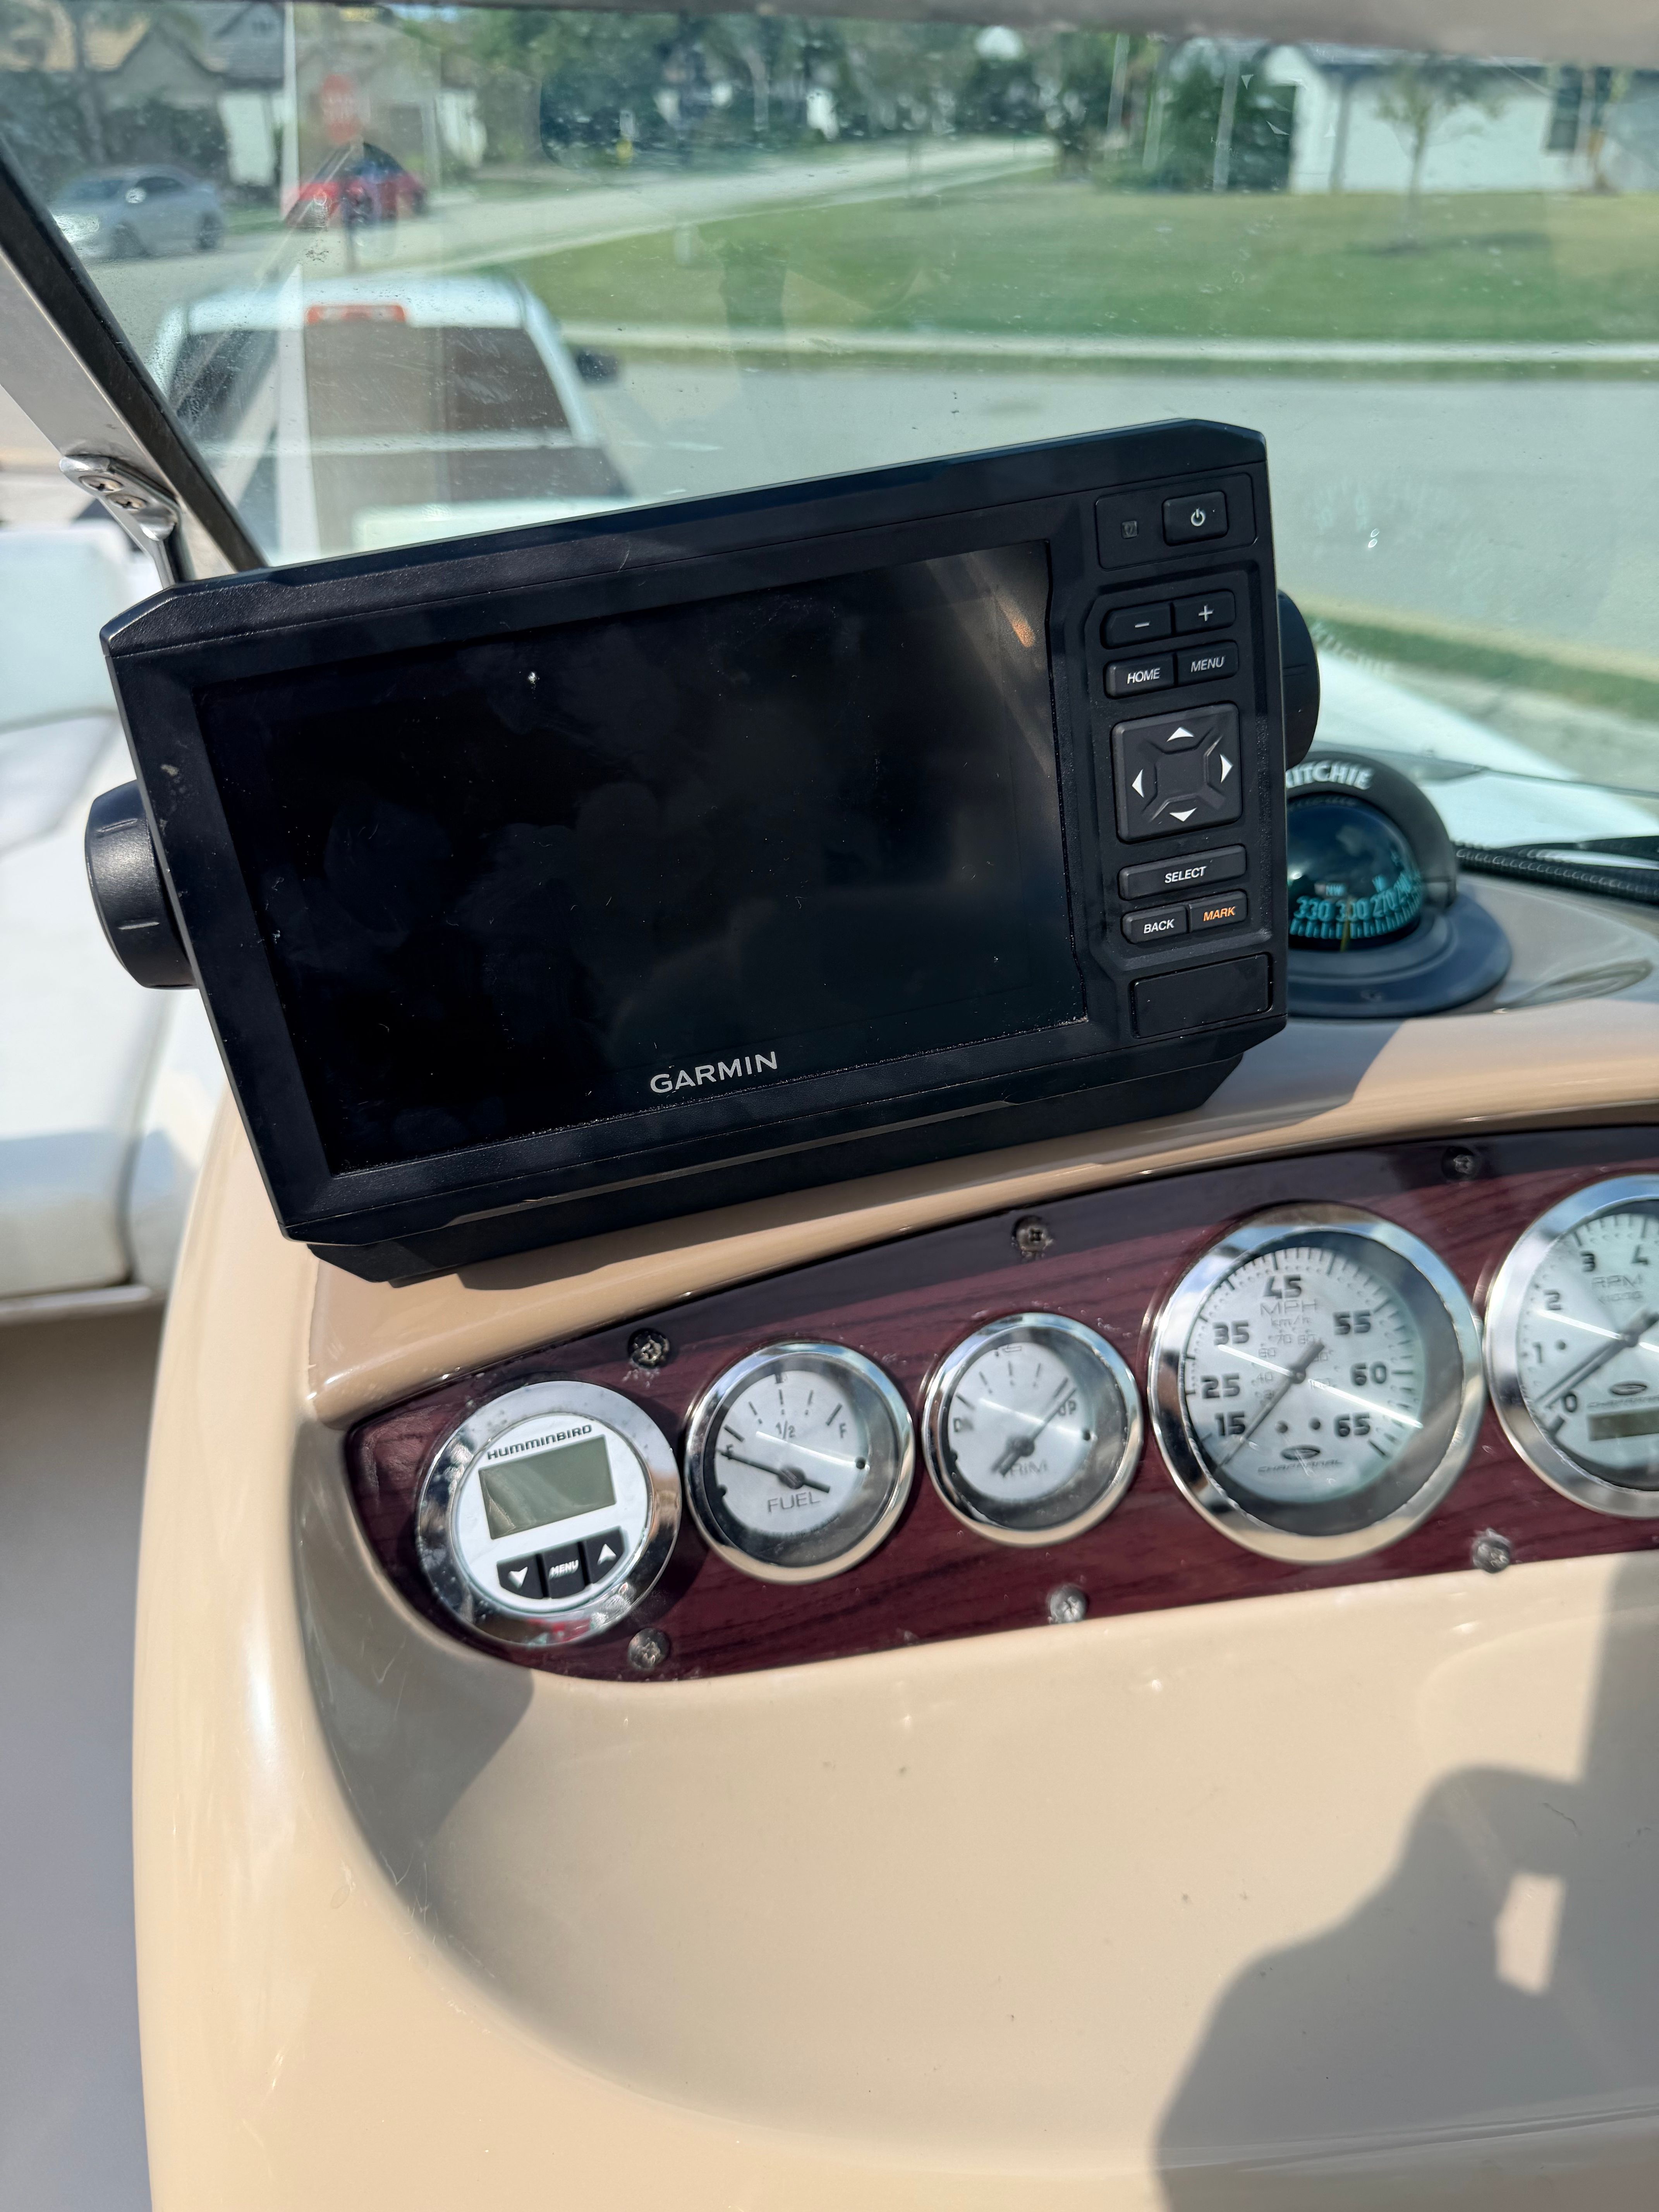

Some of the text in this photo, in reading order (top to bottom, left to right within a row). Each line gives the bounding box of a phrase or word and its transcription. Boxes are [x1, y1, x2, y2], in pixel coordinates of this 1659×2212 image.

[1191, 656, 1225, 673] MENU
[1127, 668, 1160, 684] HOME
[1164, 866, 1207, 883] SELECT
[1203, 906, 1236, 921] MARK
[1144, 919, 1175, 934] BACK
[650, 1051, 777, 1093] GARMIN
[1581, 1250, 1596, 1272] 3
[1630, 1244, 1651, 1266] 4
[1263, 1274, 1302, 1298] 45
[1260, 1298, 1317, 1316] MPH
[1544, 1290, 1562, 1310] 2
[1212, 1320, 1249, 1345] 35
[1333, 1309, 1371, 1335] 55
[1533, 1342, 1543, 1364] 1
[1351, 1361, 1387, 1386] 60
[1201, 1373, 1241, 1399] 25
[1562, 1391, 1578, 1413] 0
[776, 1420, 796, 1439] 1/2
[838, 1422, 848, 1439] F
[1215, 1410, 1246, 1436] 15
[1334, 1412, 1370, 1437] 65
[487, 1424, 592, 1460] HUMMINBIRD
[1006, 1458, 1048, 1477] RIM
[767, 1491, 821, 1514] FUEL
[549, 1559, 579, 1578] MENU
